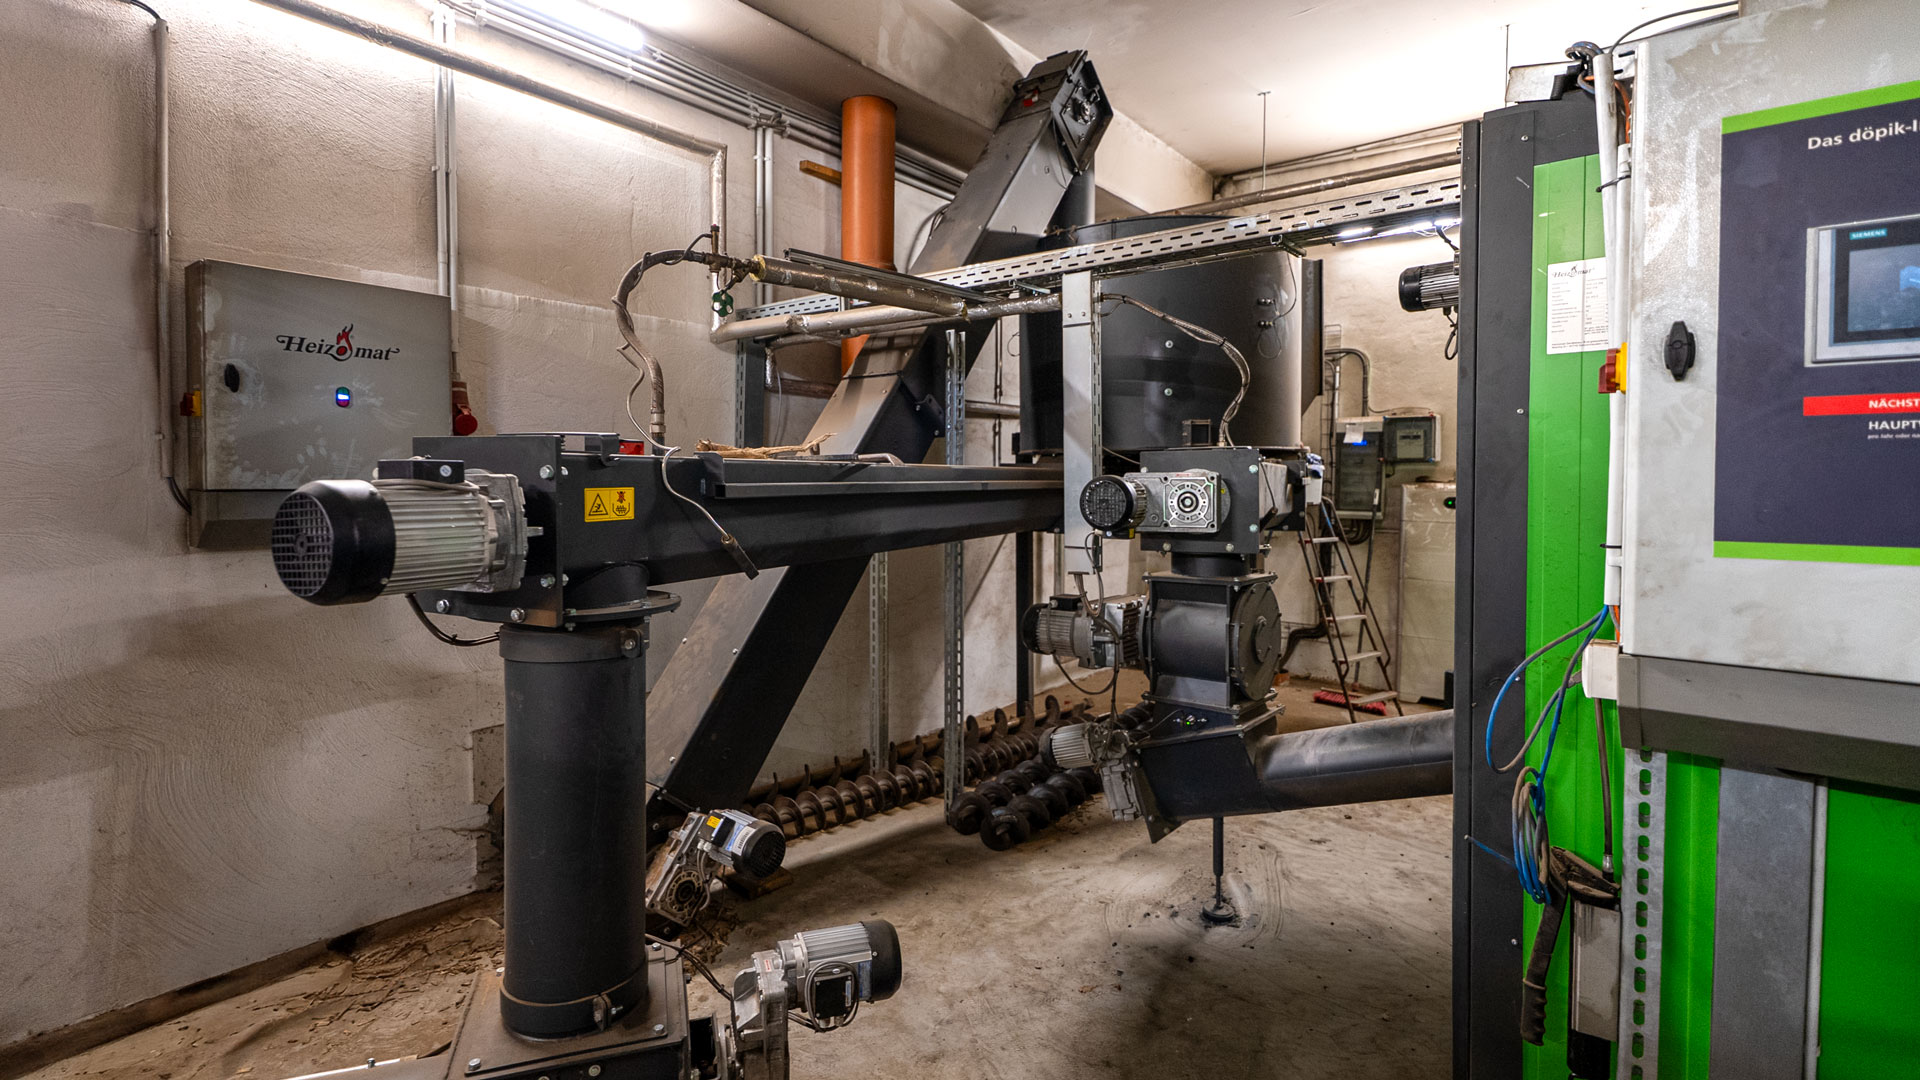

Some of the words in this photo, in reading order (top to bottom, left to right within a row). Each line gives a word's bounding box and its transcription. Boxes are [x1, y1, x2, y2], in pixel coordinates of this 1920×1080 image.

[1808, 135, 1842, 150] Das
[1849, 119, 1920, 141] döpik-I
[1852, 229, 1885, 238] SIEMENS
[1869, 420, 1920, 430] HAUPT
